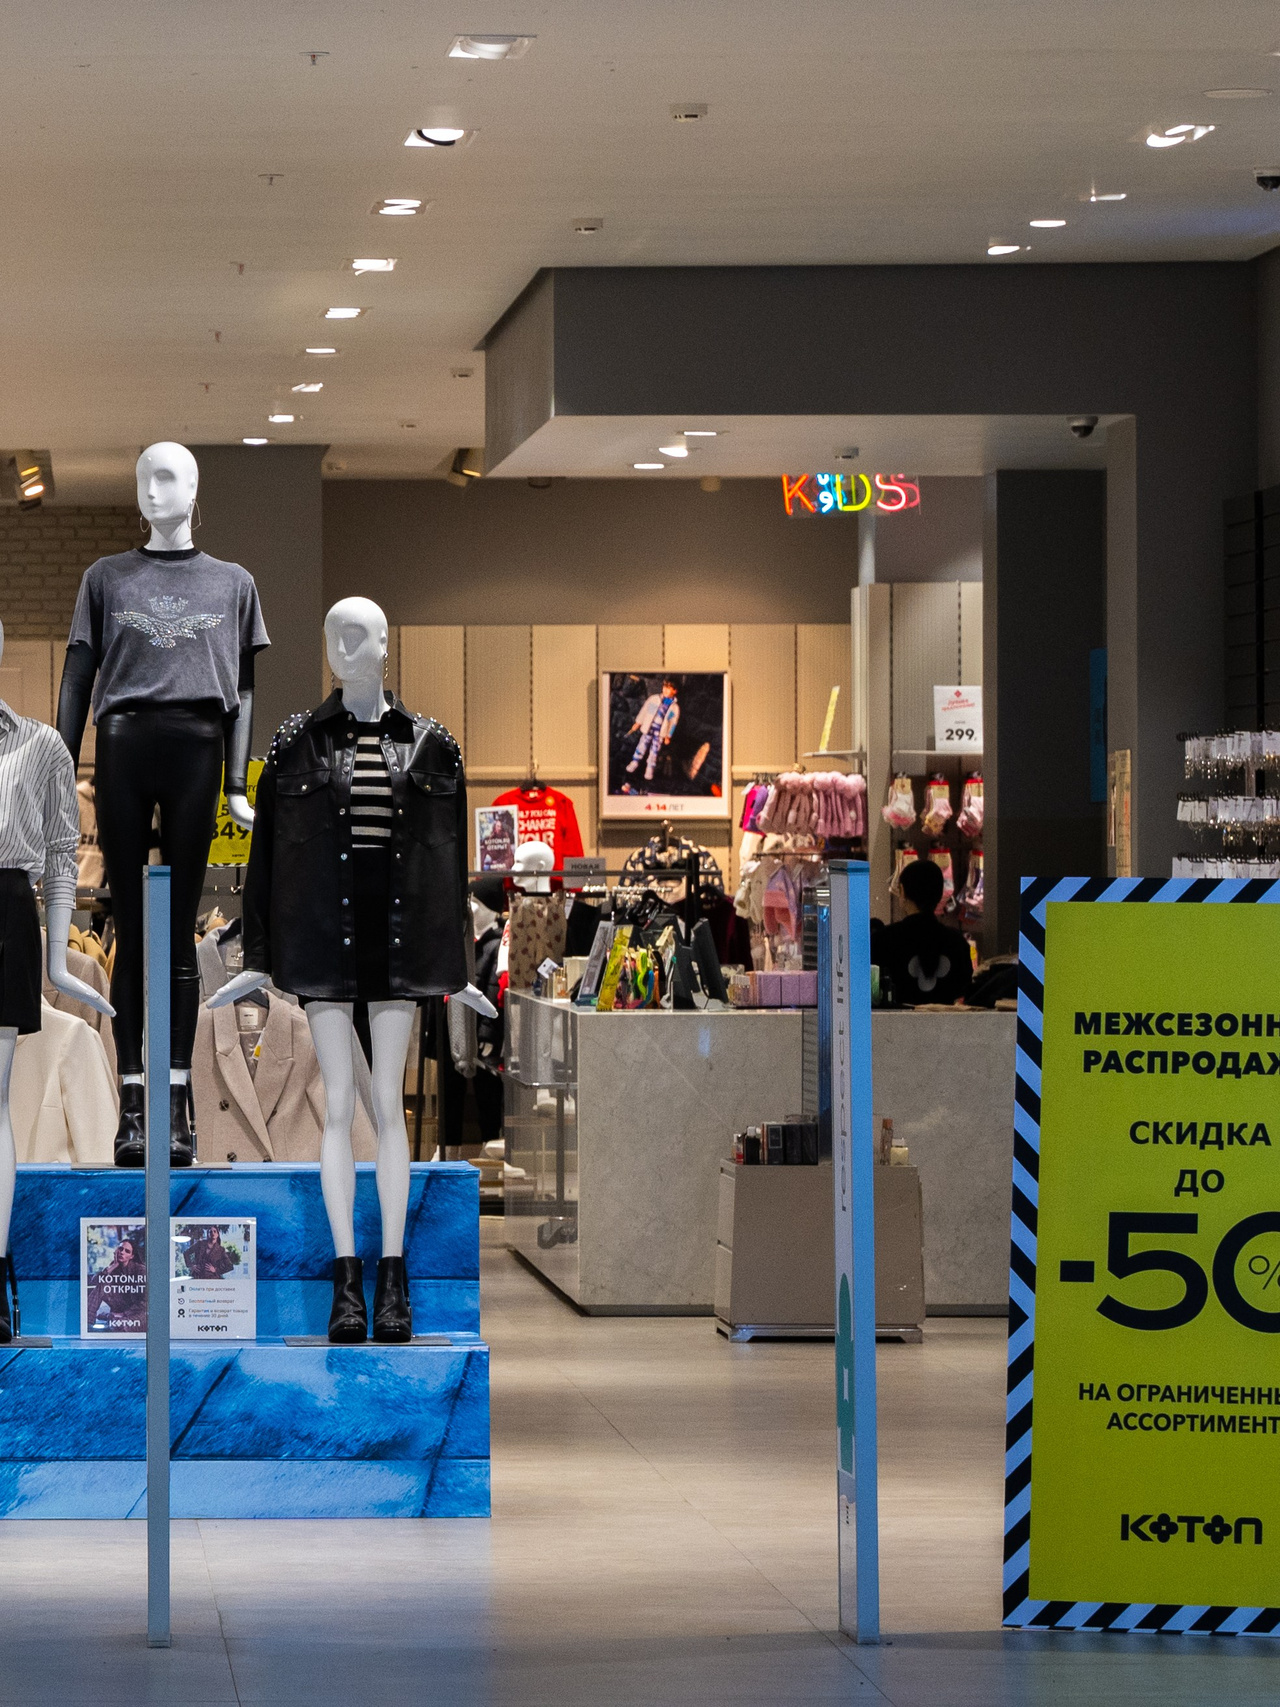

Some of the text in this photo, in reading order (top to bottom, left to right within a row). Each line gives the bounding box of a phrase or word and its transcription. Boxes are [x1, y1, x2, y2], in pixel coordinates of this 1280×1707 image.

[945, 728, 975, 741] 299
[519, 818, 556, 832] CHANGE
[1129, 1120, 1272, 1150] СКИДКА
[1174, 1169, 1225, 1197] ДО
[103, 1285, 146, 1293] ОТКРЫТ
[1078, 1383, 1280, 1405] НА ОГРАНИЧЕНН
[1106, 1412, 1280, 1434] АССОРТИМЕНТ
